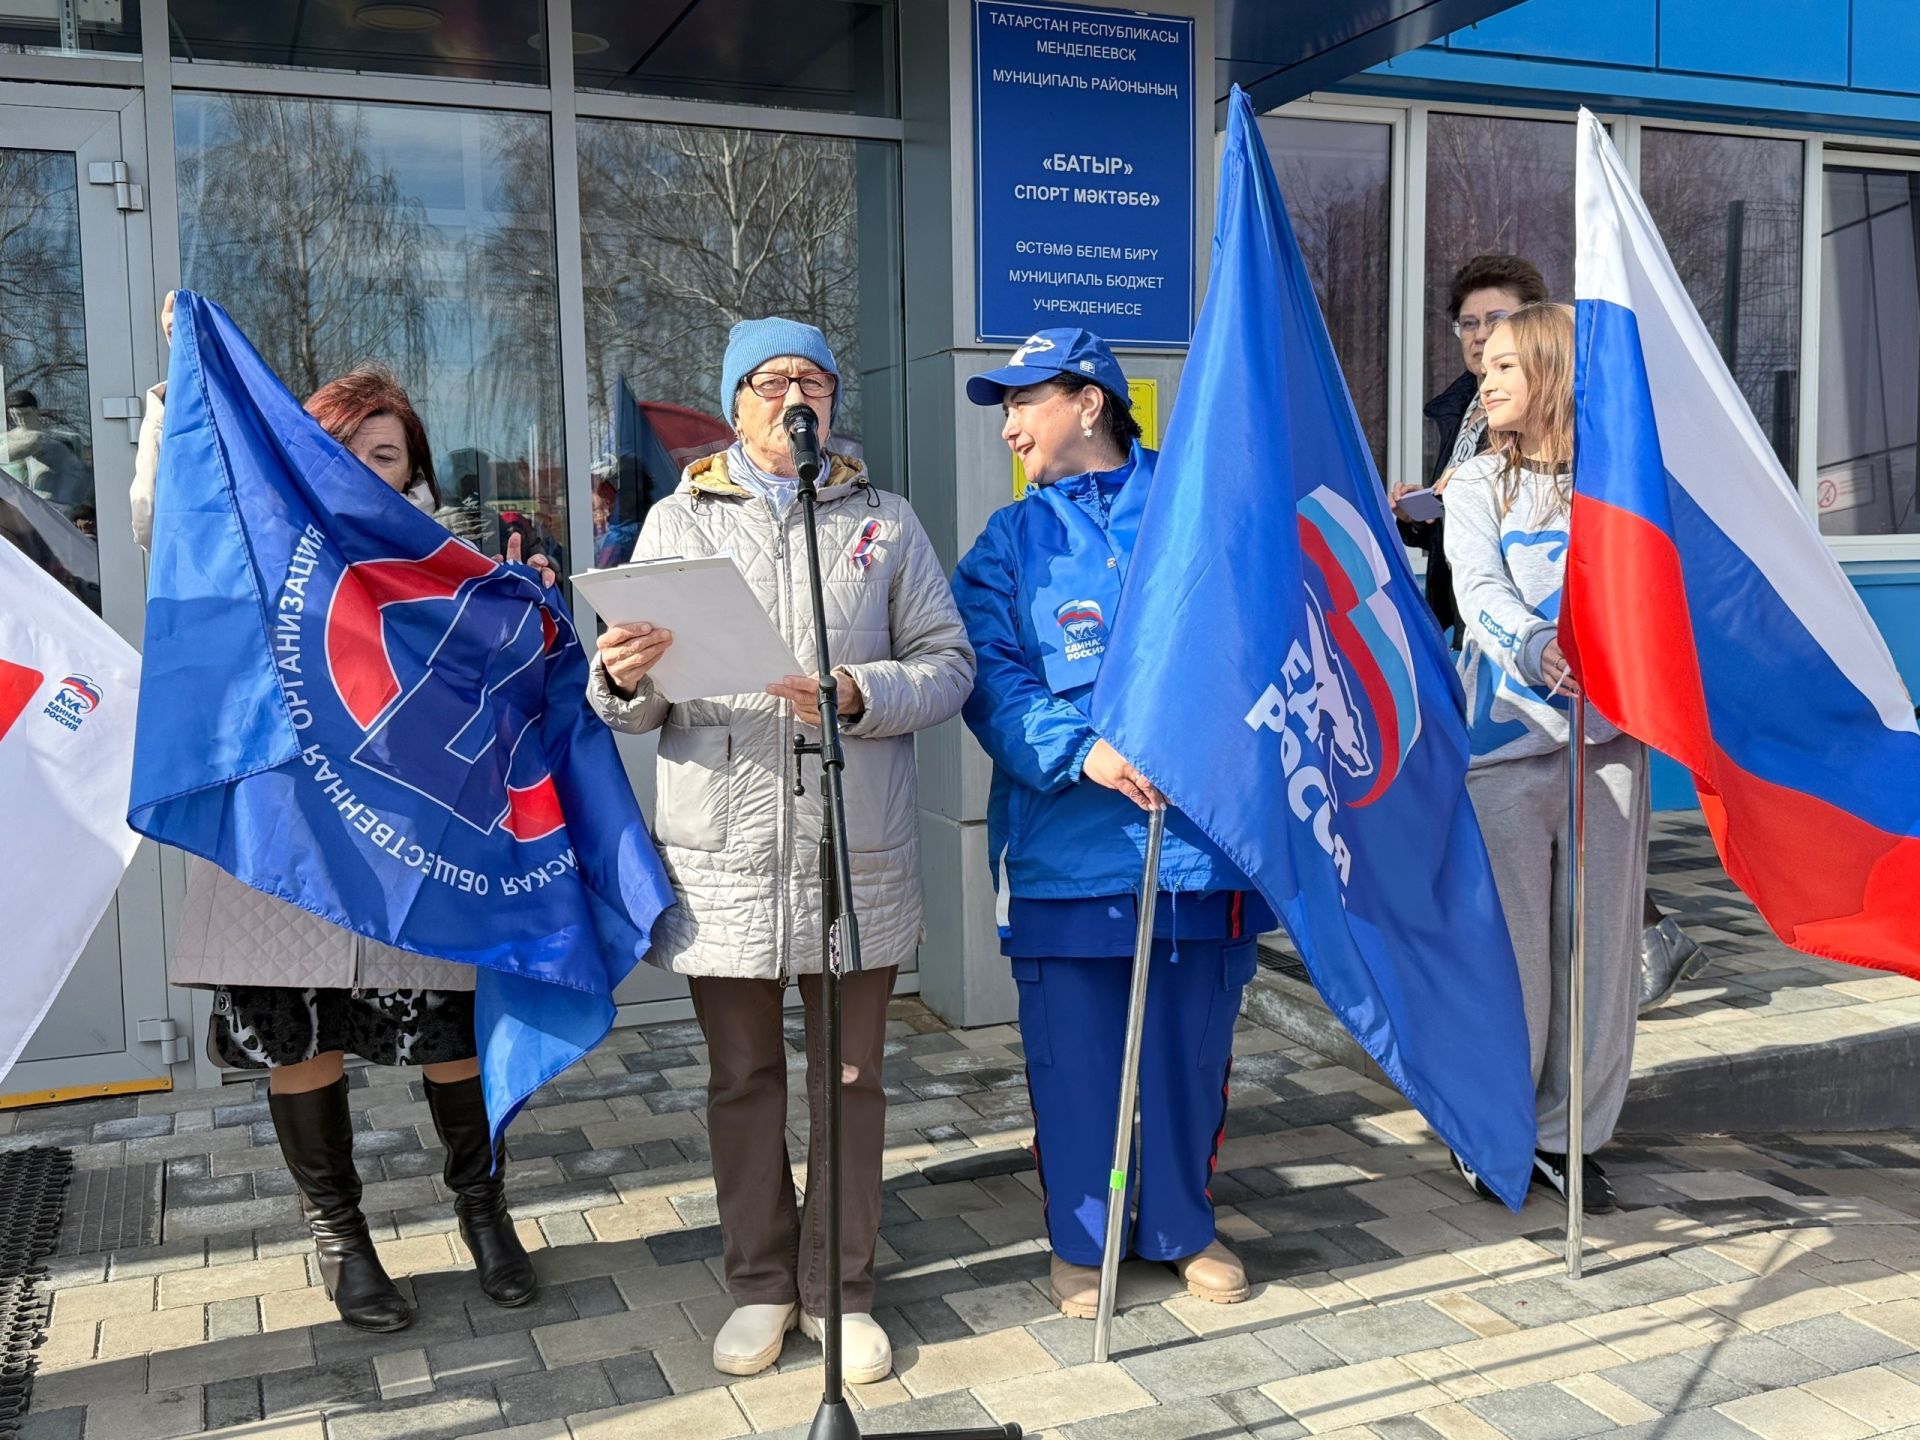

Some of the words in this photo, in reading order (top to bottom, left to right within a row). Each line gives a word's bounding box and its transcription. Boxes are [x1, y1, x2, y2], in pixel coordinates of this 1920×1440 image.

[990, 12, 1069, 33] ТАТАРСТАН
[1072, 22, 1179, 44] РЕСПУБЛИКАСЫ
[1036, 40, 1136, 61] МЕНДЕЛЕЕВСК
[993, 69, 1088, 89] МУНИЦИПАЛЬ
[1091, 77, 1178, 99] РАЙОНЫНЫҢ
[1042, 153, 1134, 175] «БАТЫР»
[1014, 184, 1069, 202] СПОРТ
[1076, 245, 1121, 259] БЕЛЕМ
[1009, 269, 1103, 287] МУНИЦИПАЛЬ
[1106, 274, 1165, 290] БЮДЖЕТ
[1033, 298, 1142, 316] УЧРЕЖДЕНИЕСЕ
[275, 522, 326, 730] ОРГАНИЗАЦИЯ
[43, 707, 78, 732] РОССИЯ
[47, 701, 83, 725] ЕДИНАЯ
[302, 742, 489, 896] ОБЩЕСТВЕННАЯ
